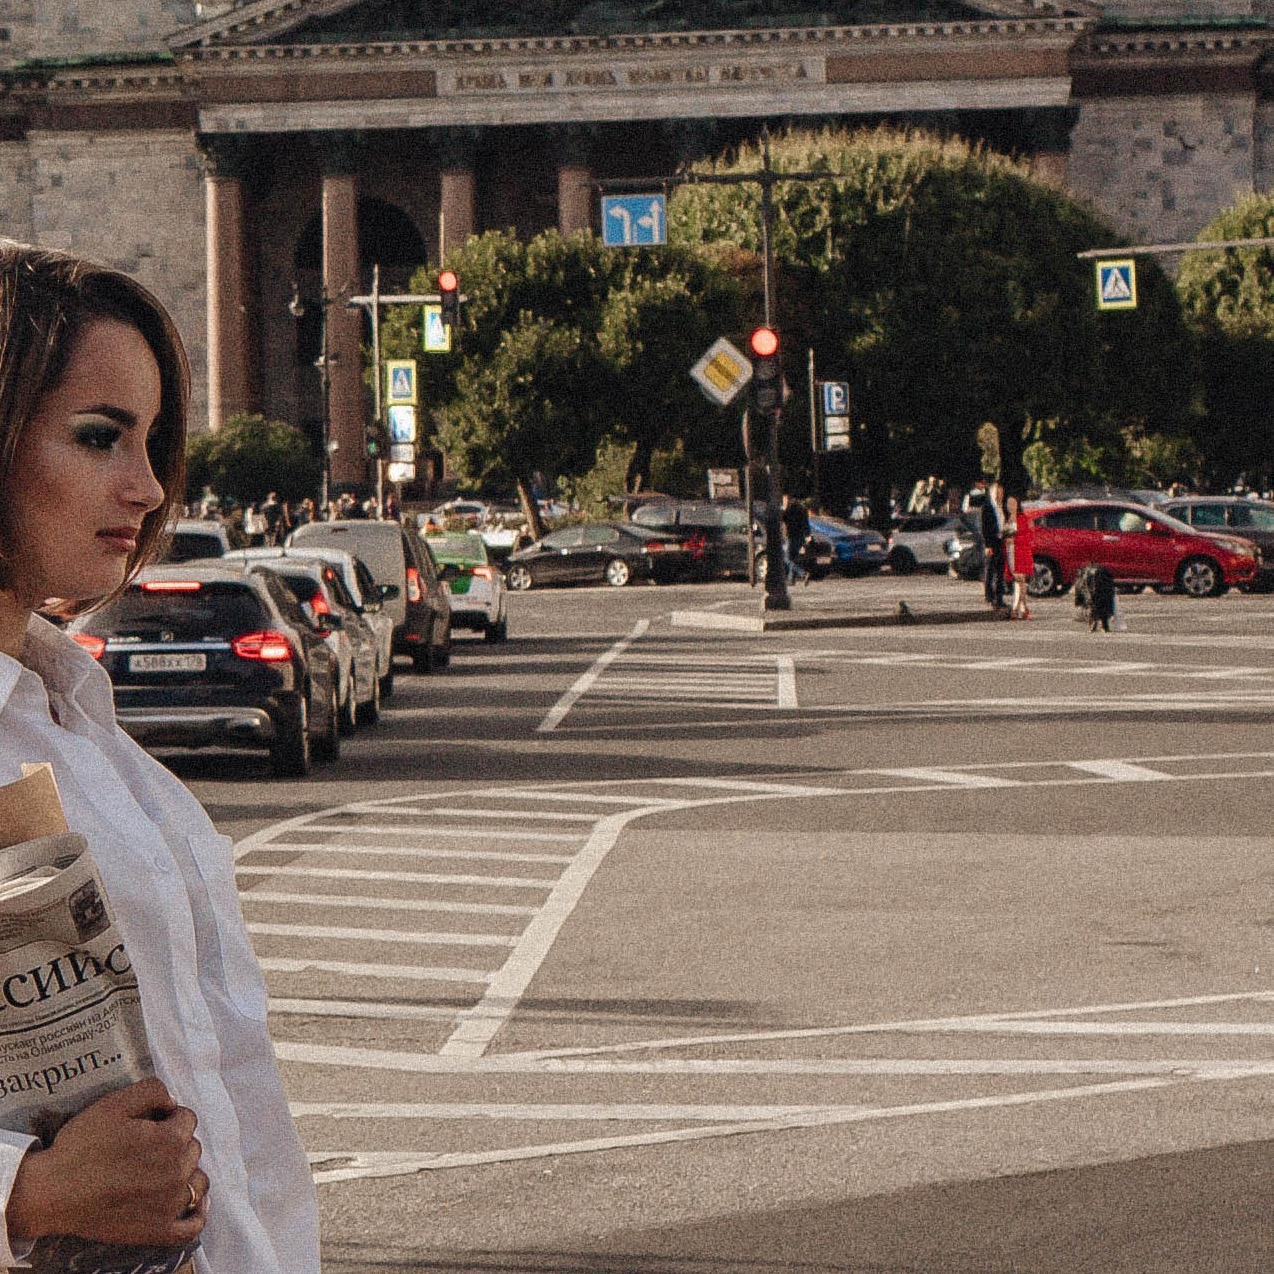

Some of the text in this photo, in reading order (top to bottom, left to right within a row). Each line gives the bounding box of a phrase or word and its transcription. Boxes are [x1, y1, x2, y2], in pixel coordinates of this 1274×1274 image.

[38, 1021, 87, 1046] россиян
[87, 1012, 101, 1024] на
[16, 1052, 29, 1062] на
